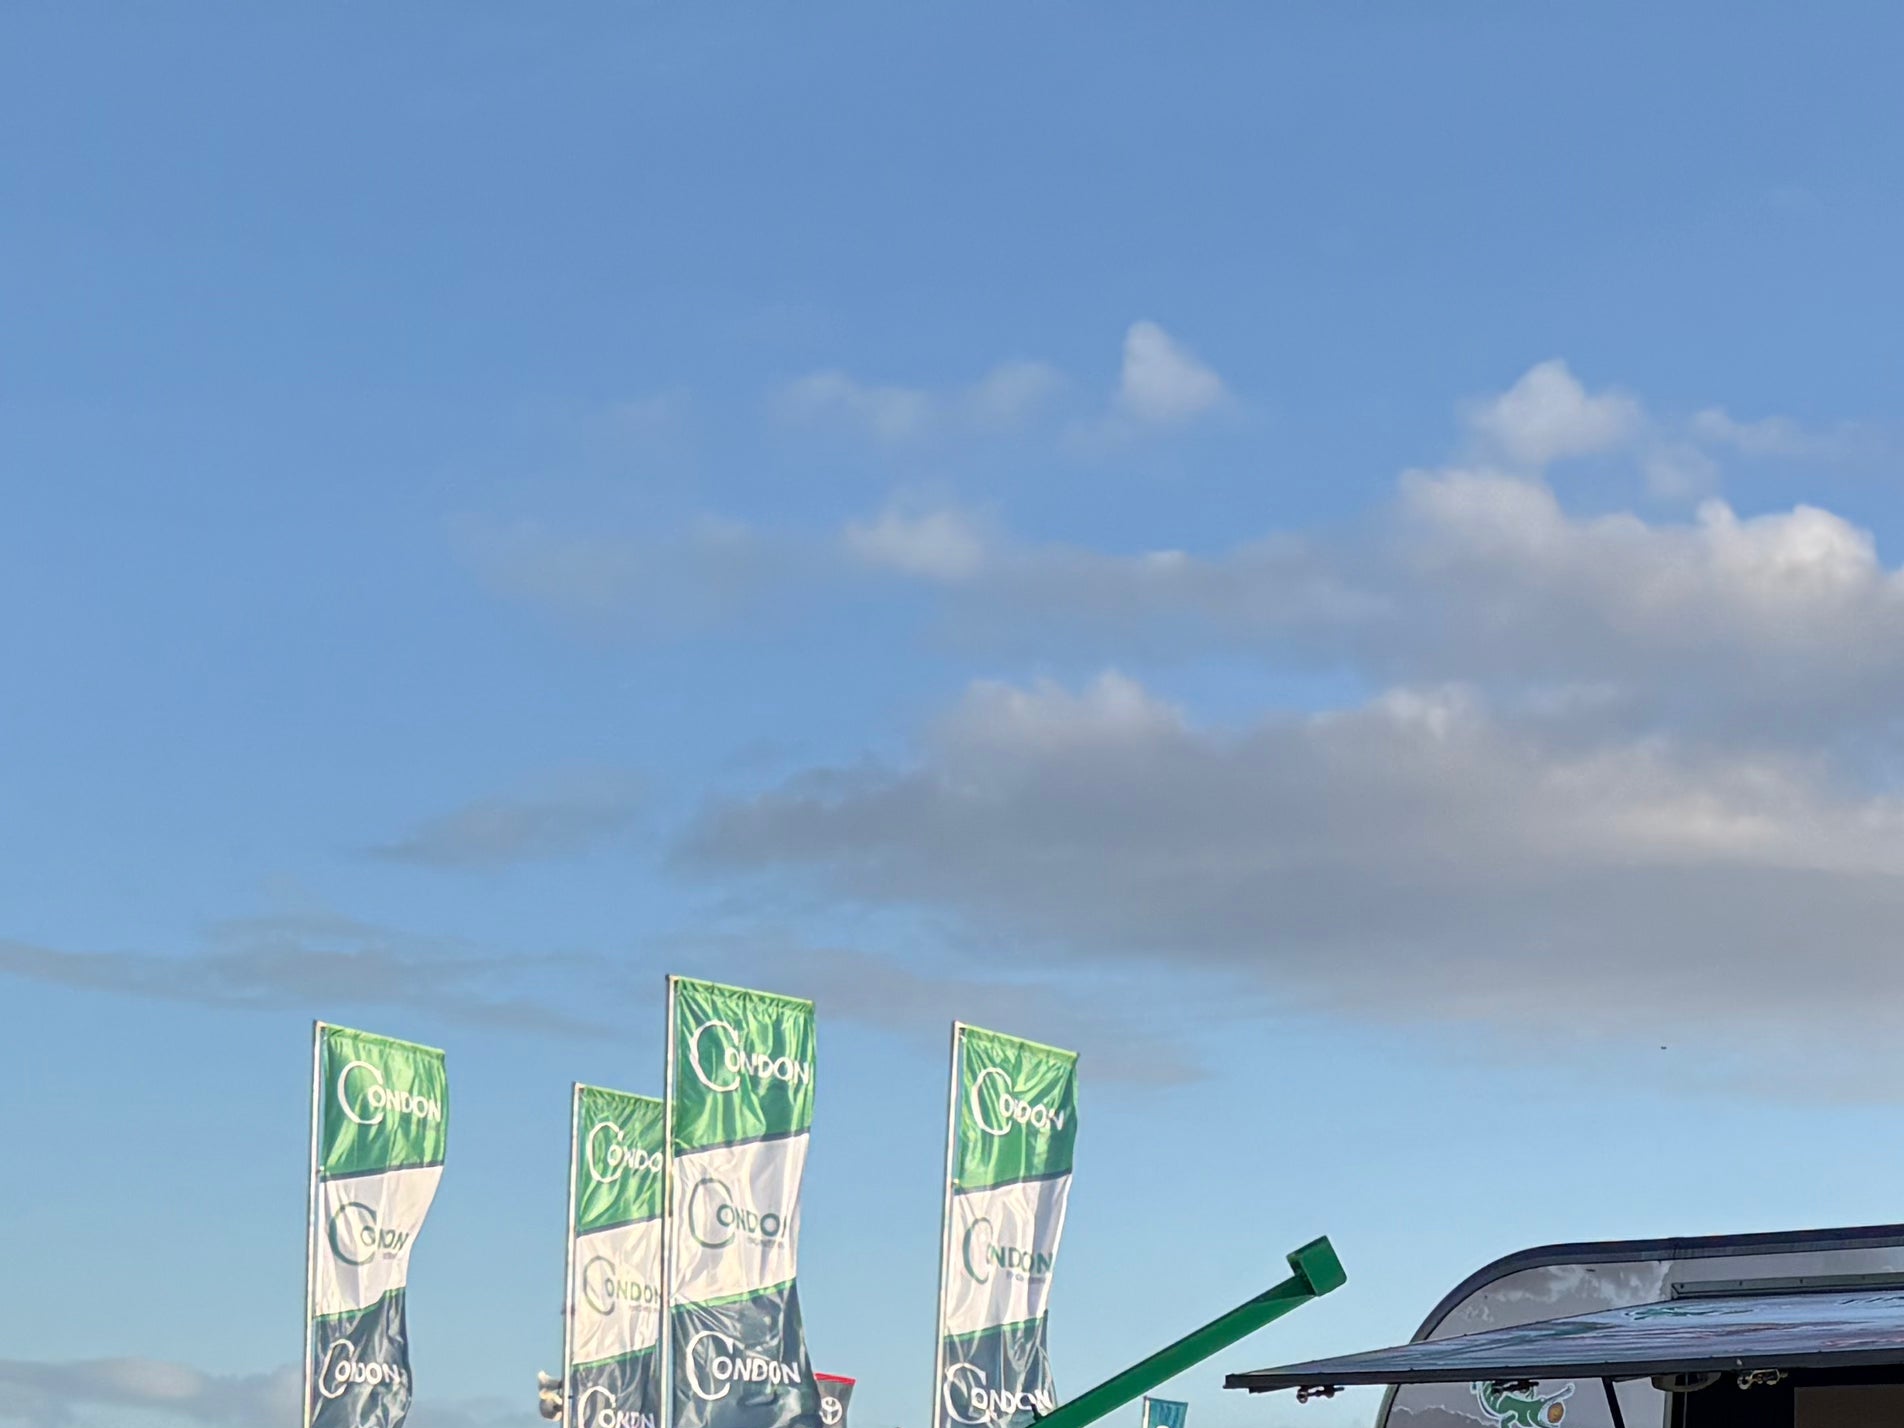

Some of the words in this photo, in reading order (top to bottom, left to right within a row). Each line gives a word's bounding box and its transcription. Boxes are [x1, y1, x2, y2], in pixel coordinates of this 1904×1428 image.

[689, 1019, 810, 1093] CONDON
[337, 1060, 442, 1125] CONDON
[587, 1121, 663, 1184] CONDO
[686, 1329, 802, 1401] CONDON
